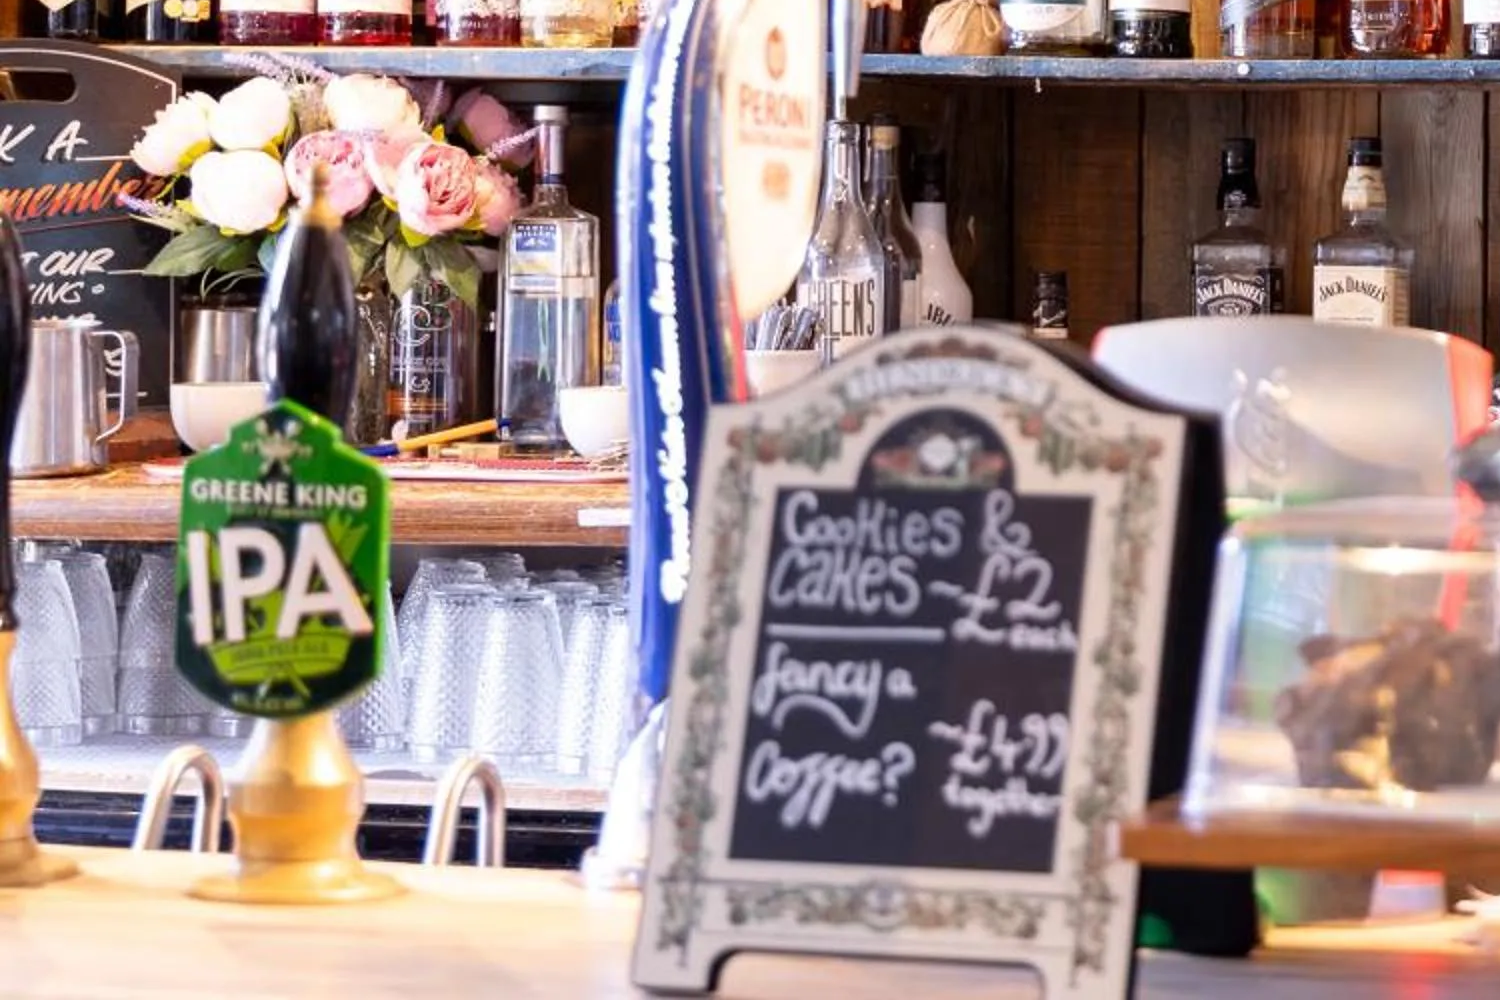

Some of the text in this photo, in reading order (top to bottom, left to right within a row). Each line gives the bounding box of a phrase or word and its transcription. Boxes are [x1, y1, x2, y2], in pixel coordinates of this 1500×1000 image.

[44, 119, 89, 161] A
[39, 247, 115, 276] OUR
[1319, 283, 1345, 303] JACK
[190, 477, 368, 510] GREENE KING
[782, 488, 1037, 558] Cookies &
[186, 521, 374, 647] IPA
[768, 544, 922, 616] Cakes
[885, 667, 918, 699] a
